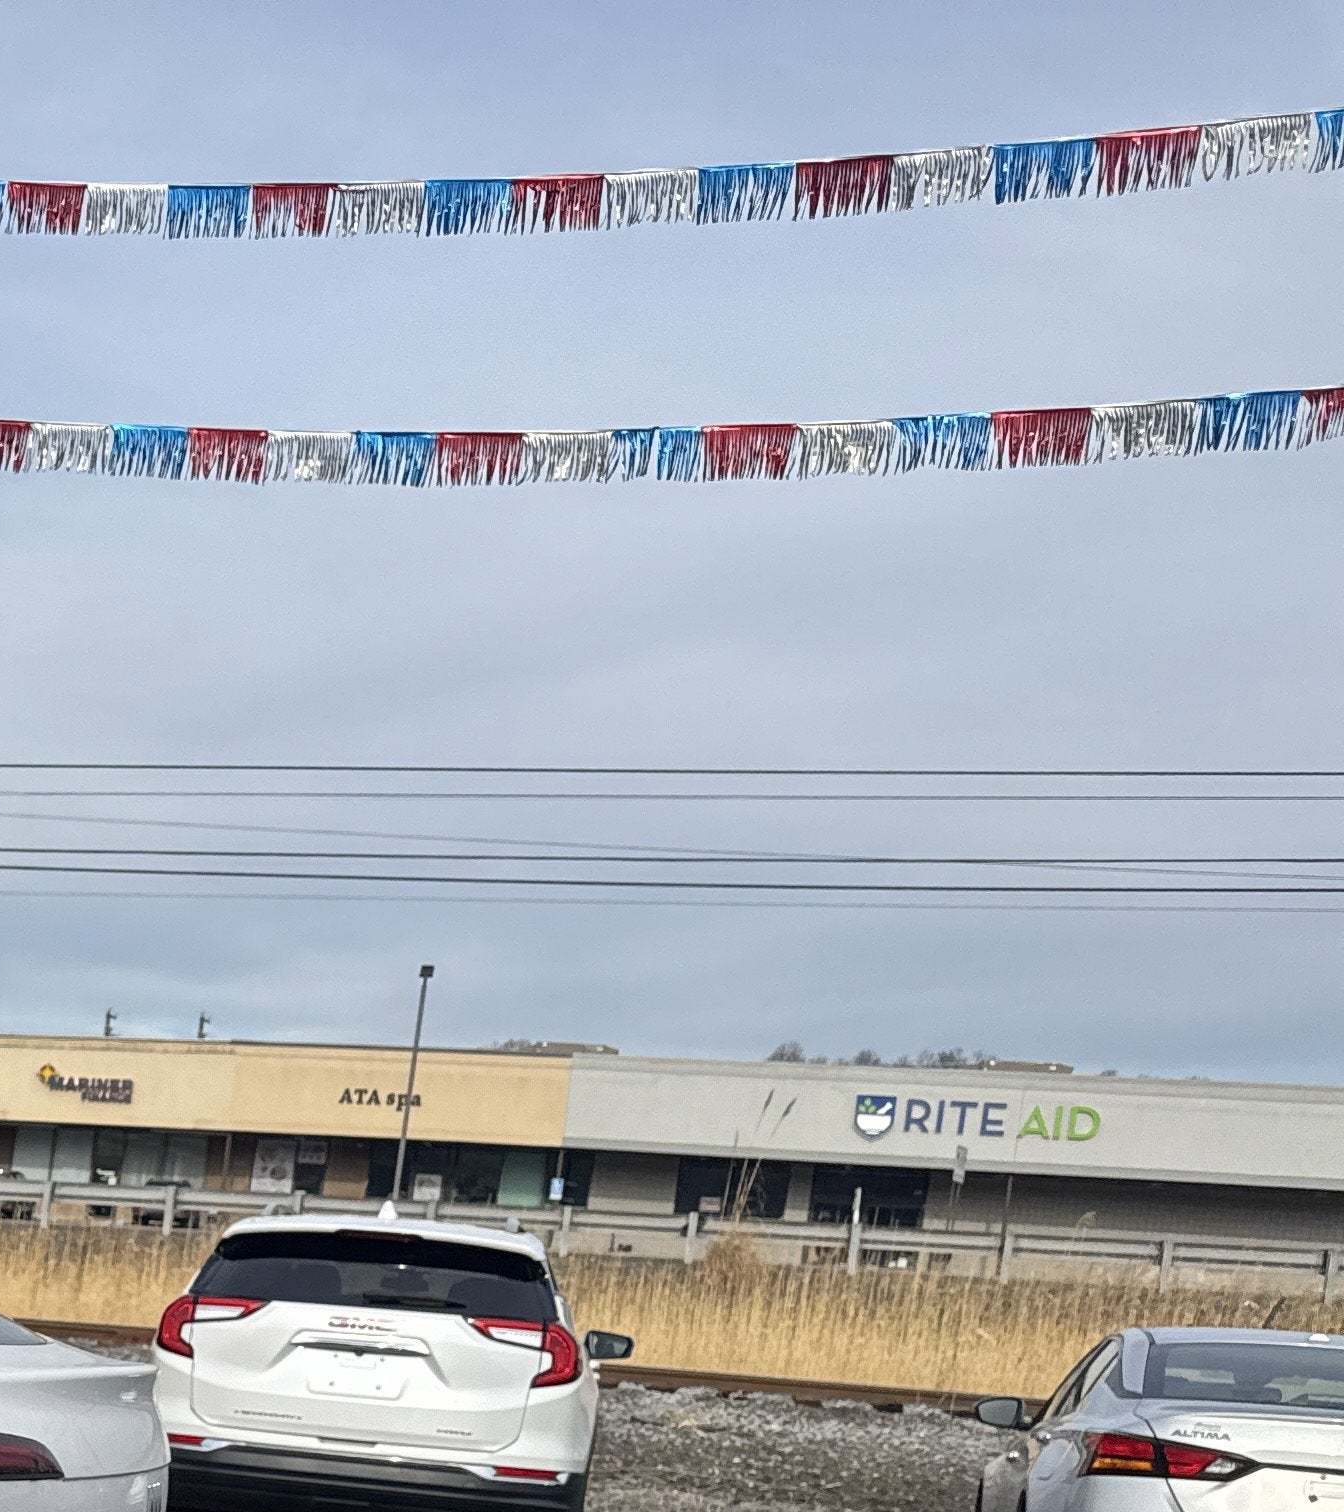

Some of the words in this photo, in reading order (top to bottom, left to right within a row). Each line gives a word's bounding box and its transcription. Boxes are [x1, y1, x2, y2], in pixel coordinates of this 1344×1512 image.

[48, 1075, 134, 1093] MARINER
[338, 1087, 381, 1106] ATA
[386, 1092, 421, 1112] spa
[903, 1097, 1008, 1138] RITE
[1016, 1104, 1102, 1142] AID
[1171, 1428, 1232, 1441] ALTIMA
